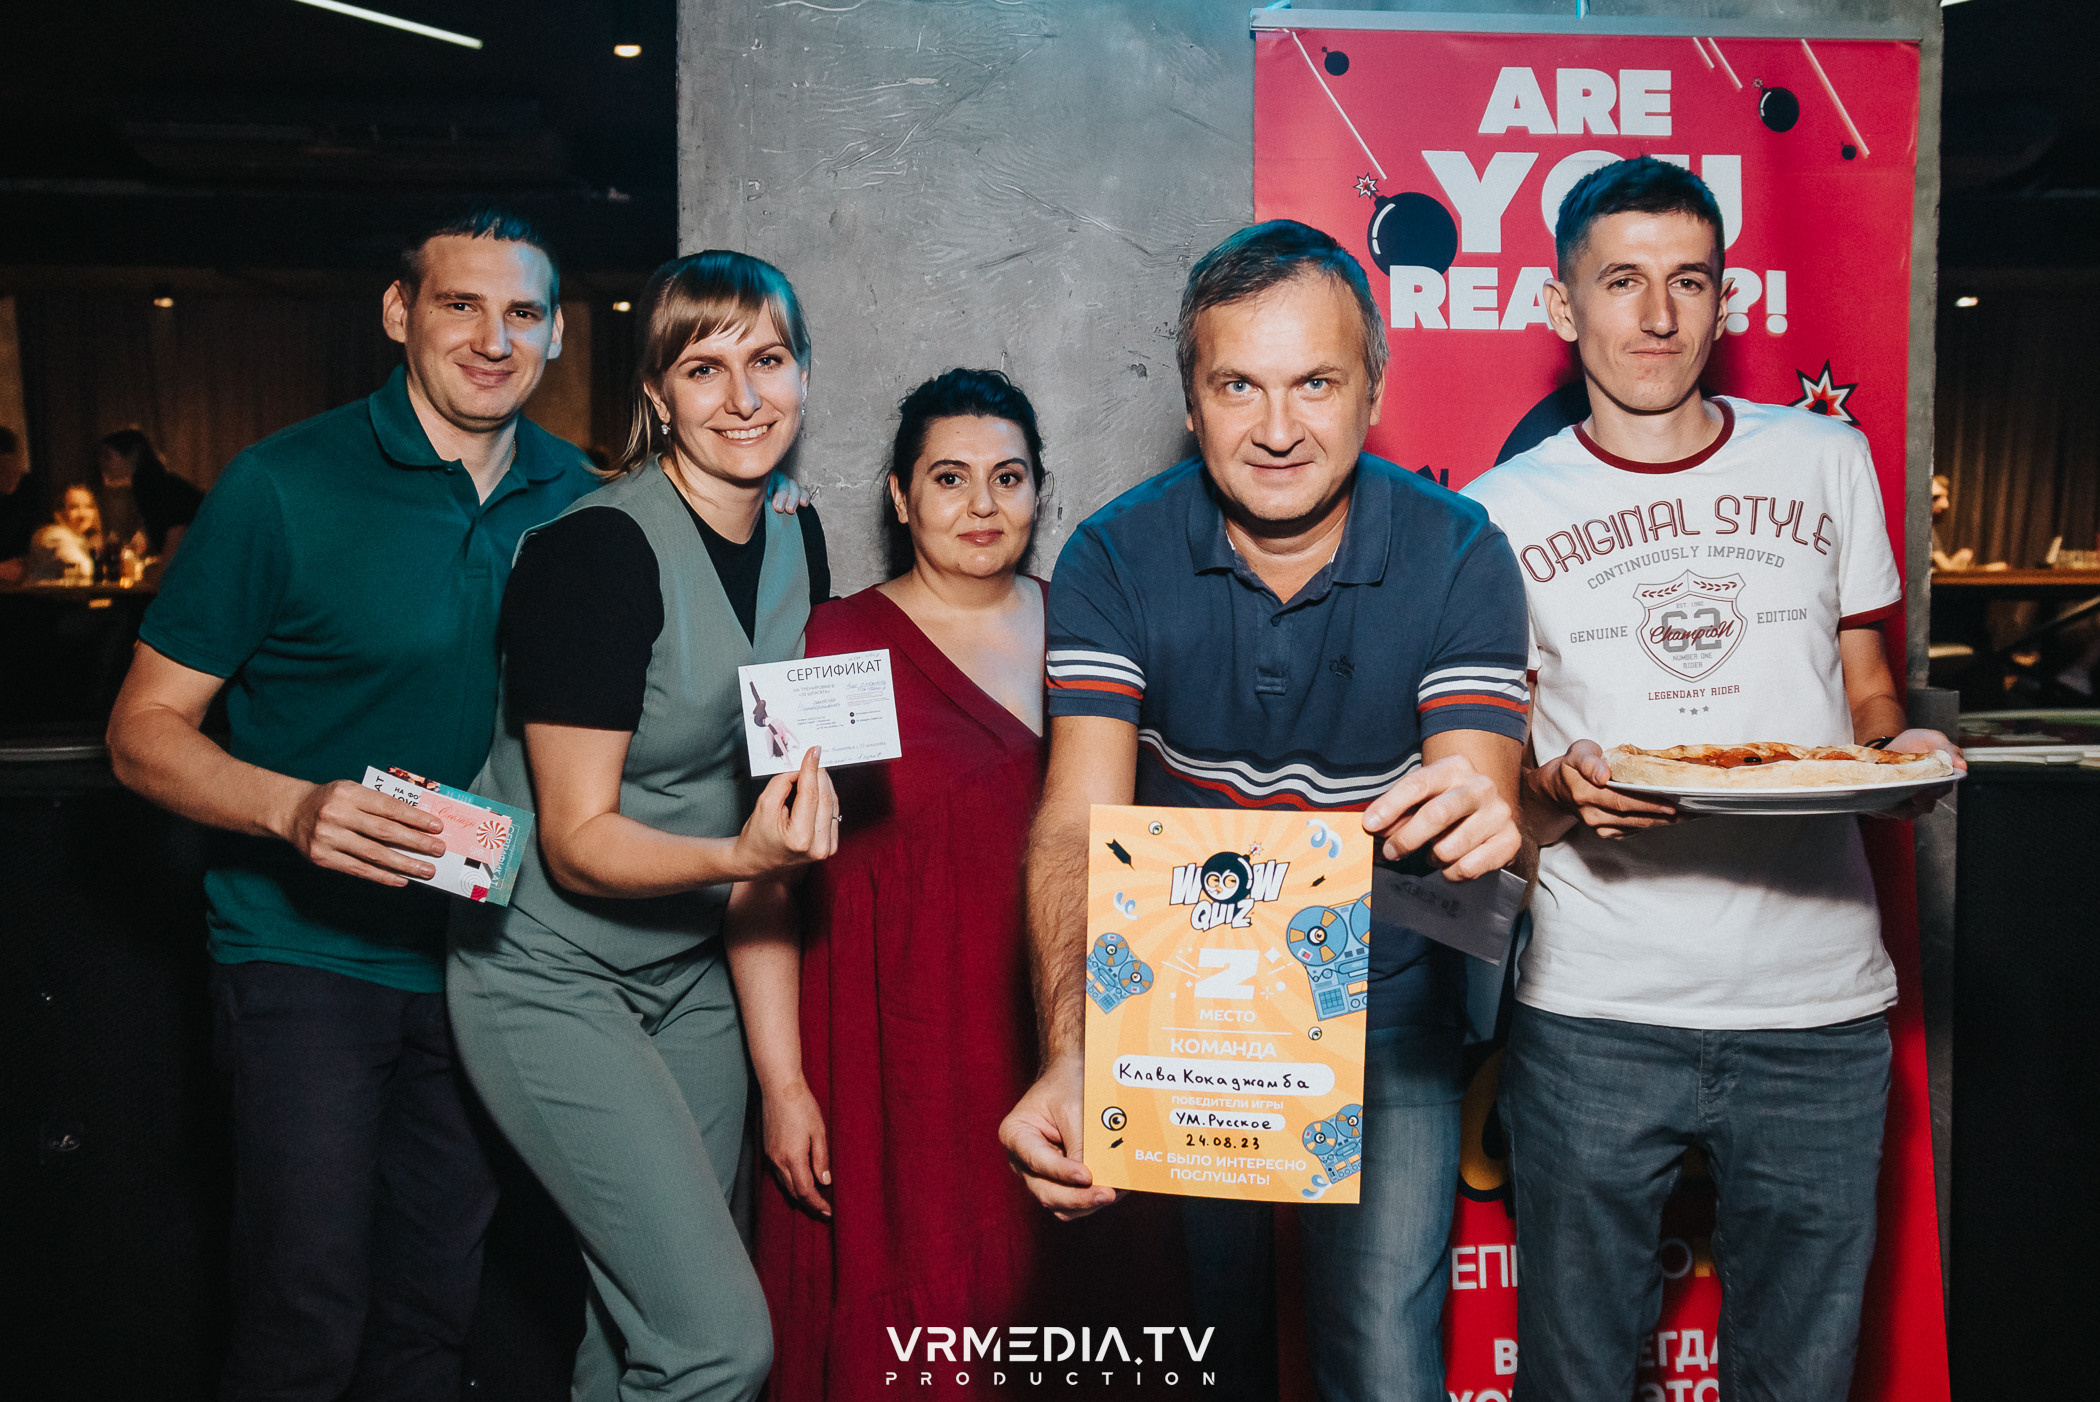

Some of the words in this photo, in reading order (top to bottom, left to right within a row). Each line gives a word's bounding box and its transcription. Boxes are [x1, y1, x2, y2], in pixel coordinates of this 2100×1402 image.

[1478, 66, 1672, 136] ARE
[1519, 497, 1701, 584] ORIGINAL
[1714, 494, 1834, 556] STYLE
[1586, 545, 1700, 590] CONTINUOUSLY
[1707, 545, 1786, 569] IMPROVED
[1569, 625, 1628, 644] GENUINE
[1661, 607, 1722, 653] 62
[1756, 607, 1808, 625] EDITION
[1672, 653, 1698, 662] NUMBER
[1700, 652, 1714, 660] ONE
[1682, 661, 1704, 670] RIDER
[786, 659, 882, 683] СЕРТИФИКАТ
[1648, 688, 1707, 701] LEGENDARY
[1711, 684, 1741, 697] RIDER
[1190, 898, 1256, 932] QUIZ
[1194, 948, 1260, 1000] 2
[1199, 1008, 1256, 1023] МЕСТО
[1170, 1038, 1277, 1060] КОМАНДА
[1119, 1062, 1177, 1083] Клава
[1183, 1068, 1310, 1091] Кокаджамба
[1171, 1095, 1249, 1110] ПОБЕДИТЕЛИ
[1251, 1099, 1284, 1110] ИГРЫ
[1186, 1133, 1260, 1150] 24.08.23
[1135, 1149, 1164, 1164] ВАС
[1167, 1152, 1212, 1167] БЫЛО
[1215, 1156, 1307, 1173] ИНТЕРЕСНО
[1170, 1168, 1270, 1186] ПОСЛУШАТЬ!
